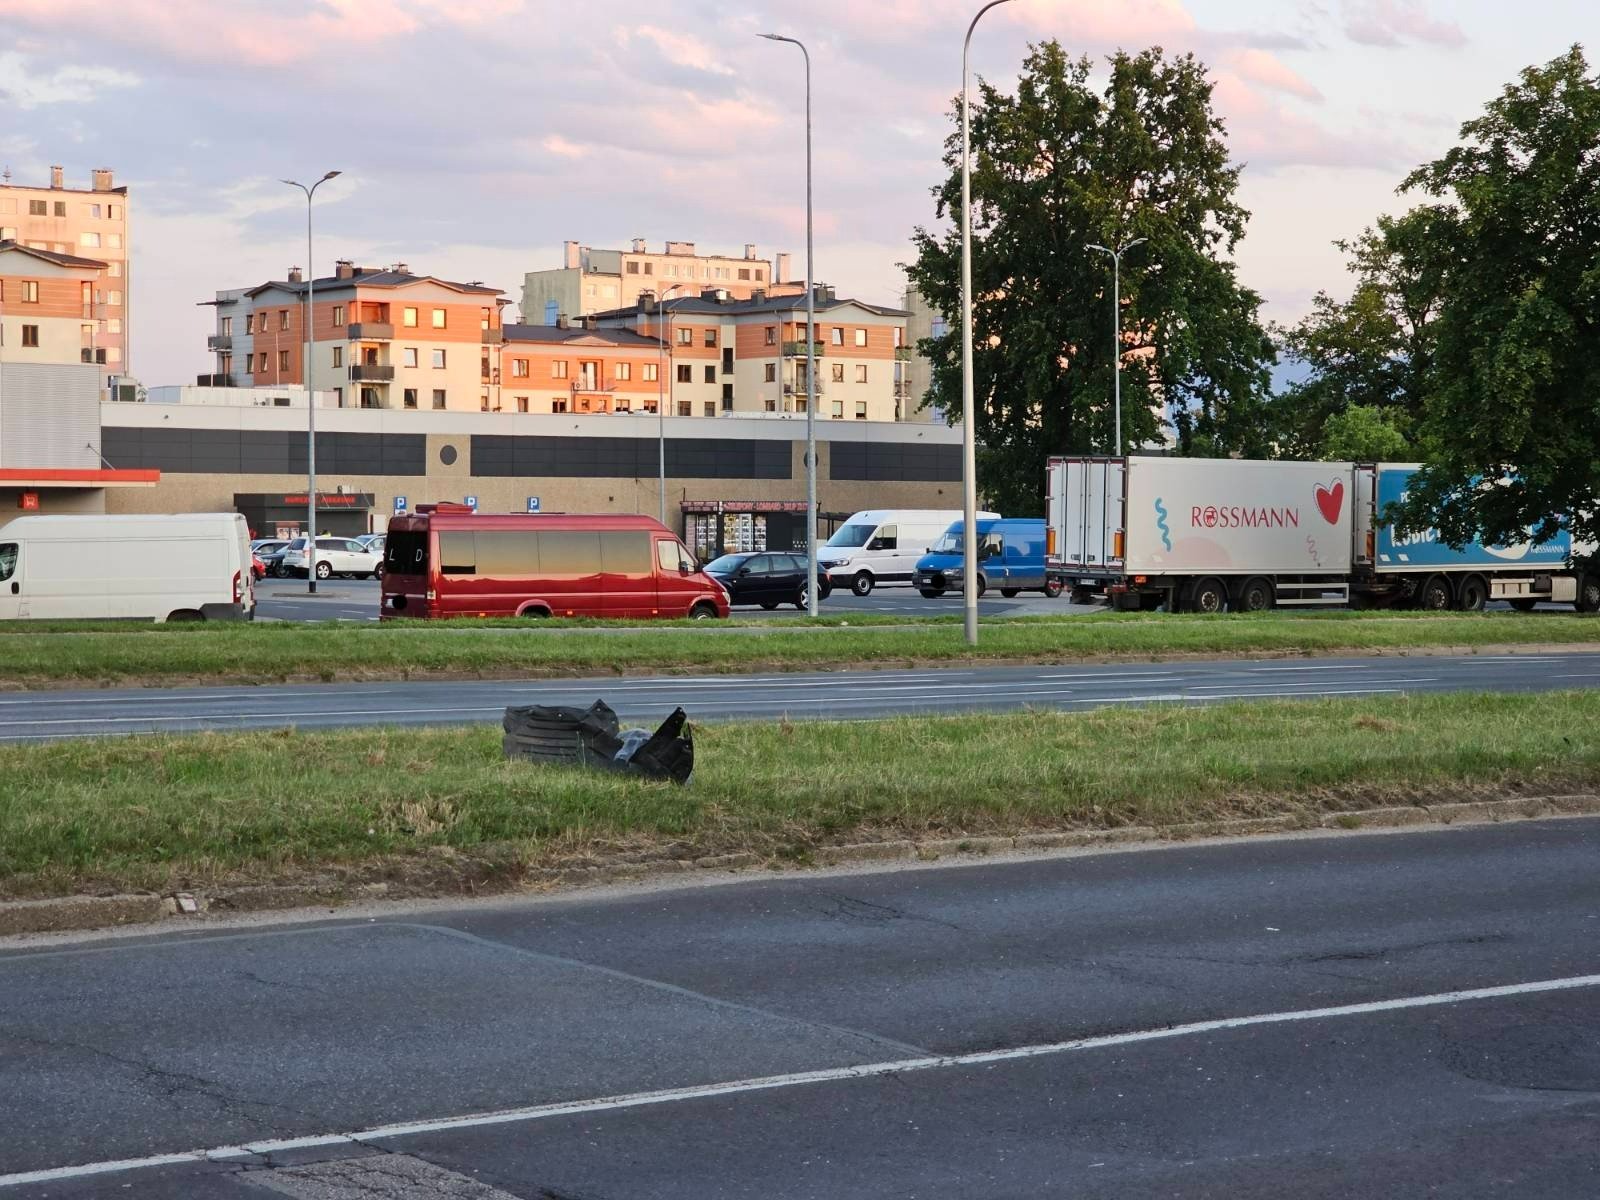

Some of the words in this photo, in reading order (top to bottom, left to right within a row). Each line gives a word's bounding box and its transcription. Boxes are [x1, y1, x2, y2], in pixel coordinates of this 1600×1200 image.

[397, 497, 405, 508] P
[530, 498, 538, 508] P
[1191, 505, 1299, 528] ROSSMANN
[415, 548, 423, 562] D
